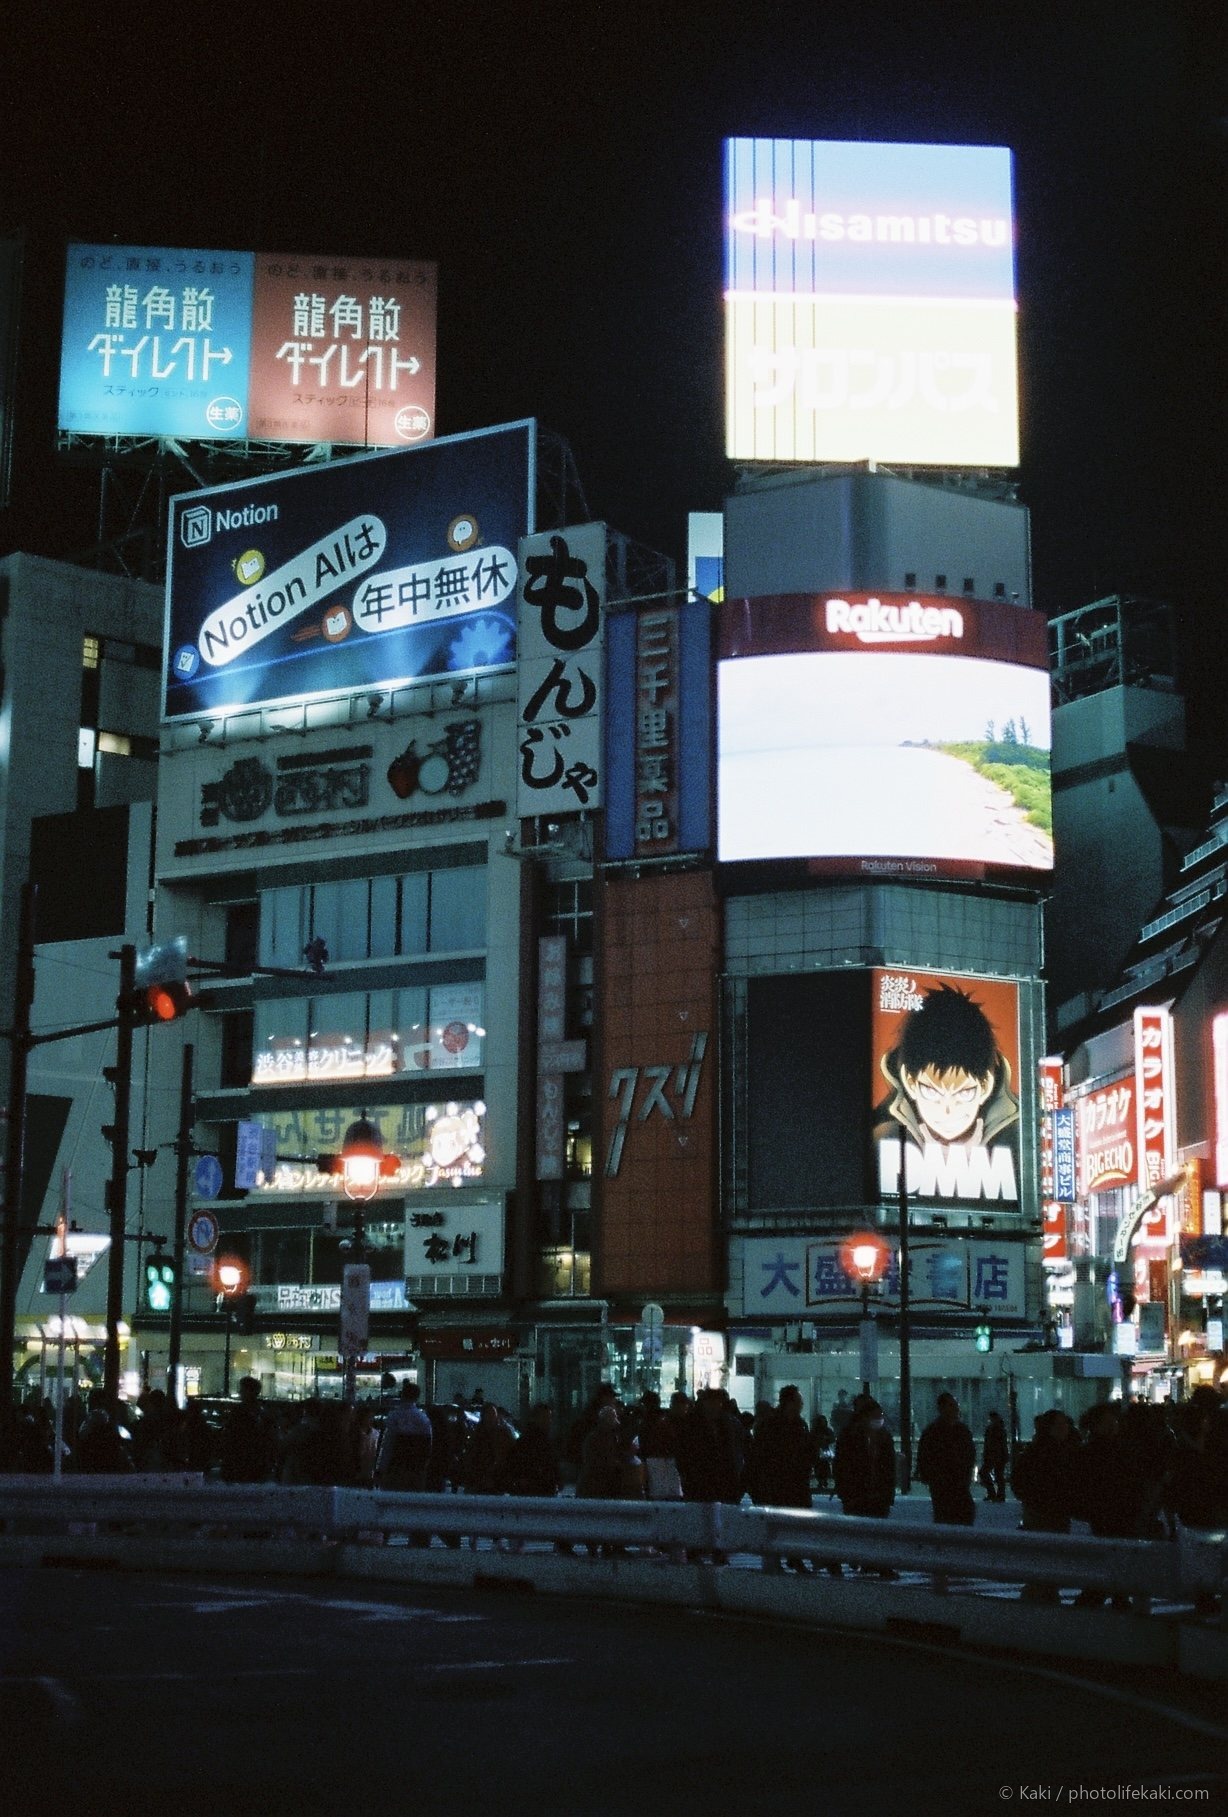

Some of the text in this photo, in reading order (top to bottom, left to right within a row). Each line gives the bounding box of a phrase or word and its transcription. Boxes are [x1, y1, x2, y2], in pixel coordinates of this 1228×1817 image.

[735, 198, 1007, 246] Hisamitsu
[105, 284, 214, 332] 龍角散
[293, 293, 401, 342] 龍角散
[87, 334, 233, 381] ダイレクト
[275, 342, 420, 391] ダイレクト
[750, 346, 1000, 413] サロンパス
[216, 504, 279, 533] Notion
[360, 553, 509, 624] 年中無休
[203, 577, 307, 659] Notion
[825, 598, 964, 639] Rakuten
[519, 535, 600, 805] もんじゃ
[861, 860, 937, 872] Rakuten Vision
[604, 1031, 709, 1178] クスリ
[1140, 1026, 1165, 1139] カラオケ
[1086, 1087, 1132, 1133] カラオケ
[879, 1138, 1018, 1201] DMM
